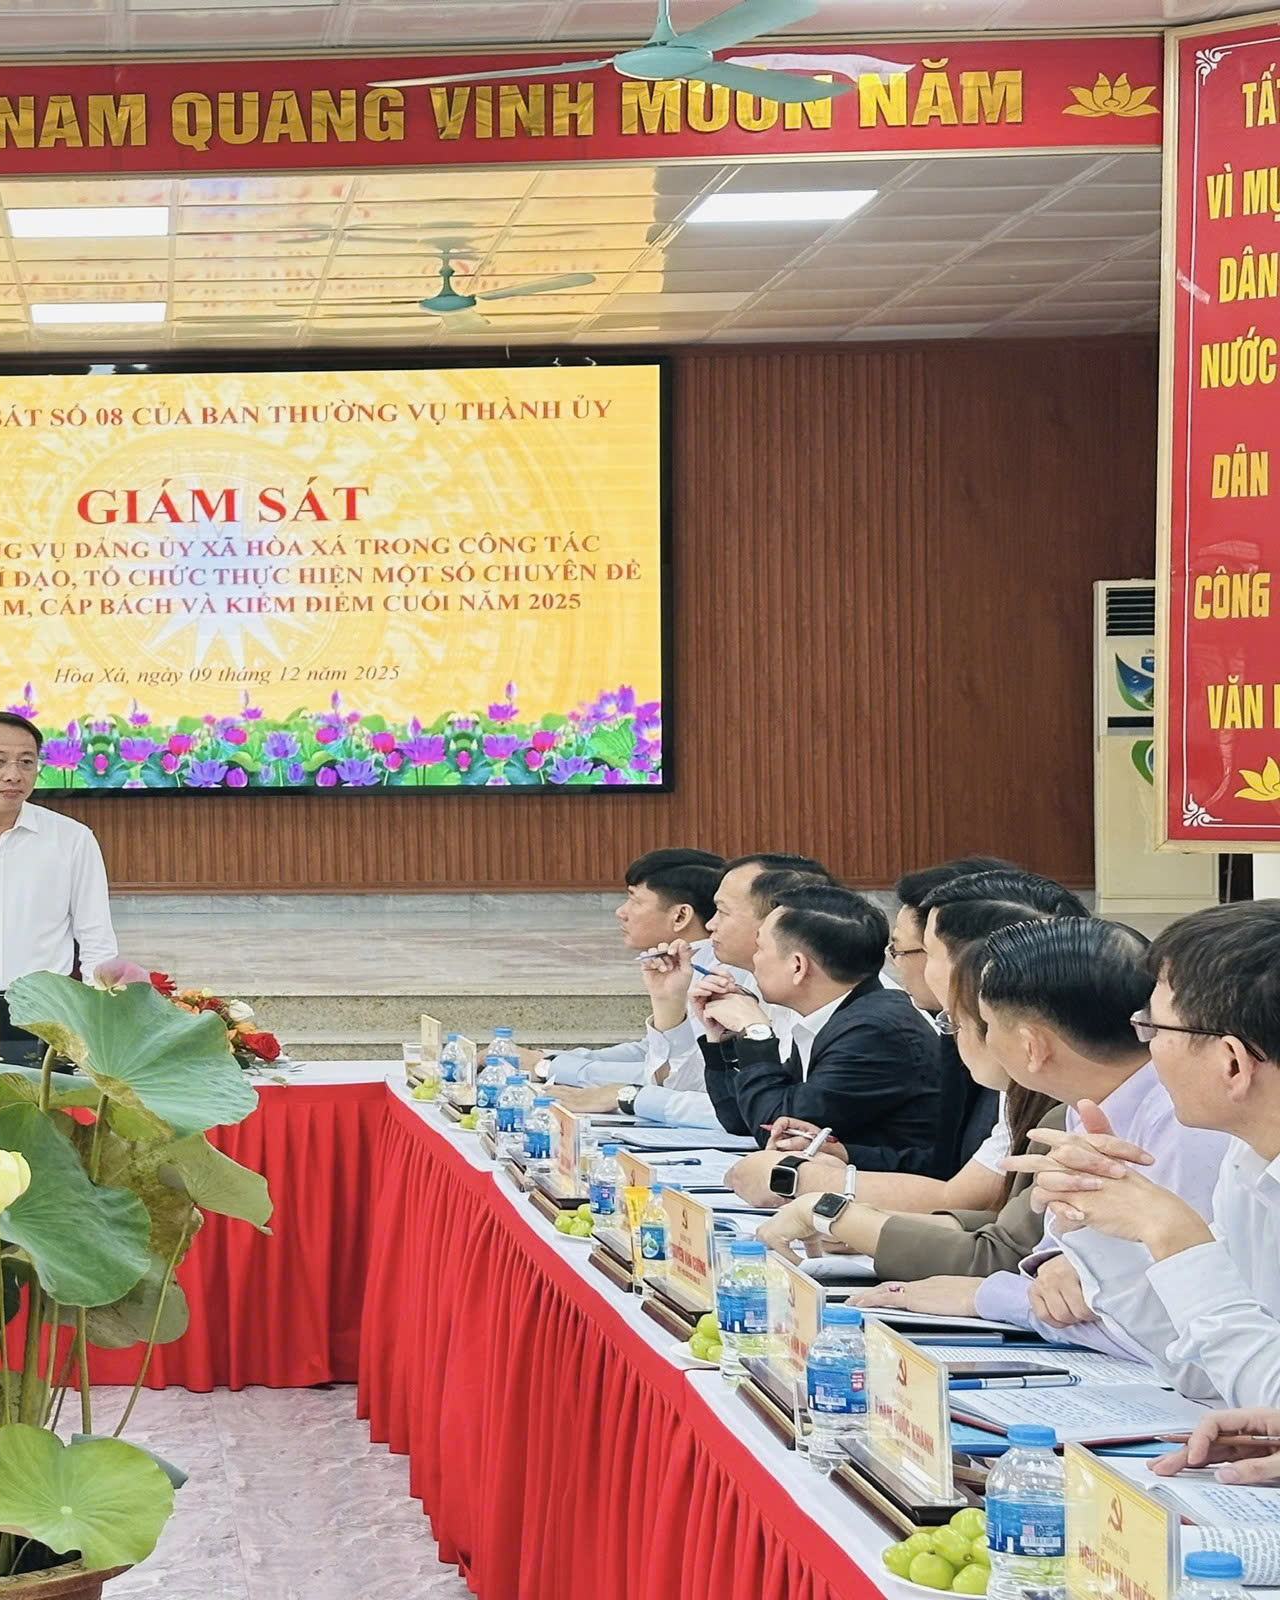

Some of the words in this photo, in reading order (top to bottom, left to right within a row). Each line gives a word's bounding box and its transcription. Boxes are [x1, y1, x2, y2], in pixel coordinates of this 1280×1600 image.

[171, 88, 406, 153] QUANG
[430, 80, 596, 141] VINH
[858, 57, 1024, 129] NĂM
[1206, 163, 1234, 220] VÌ
[1219, 245, 1279, 304] DÂN
[1200, 326, 1278, 389] NƯỚC
[49, 402, 87, 427] SỐ
[96, 406, 123, 426] 08
[131, 400, 193, 426] CỦA
[202, 403, 259, 425] BAN
[268, 399, 398, 424] THƯỜNG
[408, 402, 451, 427] VỤ
[456, 396, 561, 421] THÀNH
[572, 394, 612, 420] ỦY
[1211, 444, 1269, 499] DÂN
[77, 478, 240, 525] GIÁM
[258, 476, 370, 524] SÁT
[14, 570, 78, 592] ĐẠO,
[128, 563, 208, 587] CHỨC
[216, 566, 290, 588] THỰC
[298, 563, 364, 586] HIỆN
[372, 561, 435, 587] MỘT
[441, 559, 475, 583] SỐ
[483, 557, 597, 582] CHUYÊN
[607, 557, 642, 581] ĐỀ
[31, 541, 66, 564] VỤ
[75, 537, 149, 560] ĐẢNG
[160, 535, 194, 558] ỦY
[202, 535, 238, 557] XÃ
[246, 535, 304, 557] HÒA
[311, 532, 347, 556] XÁ
[355, 537, 451, 556] TRONG
[459, 532, 537, 555] CÔNG
[544, 530, 601, 553] TÁC
[40, 593, 93, 617] CẤP
[100, 595, 172, 616] BÁCH
[180, 593, 217, 615] VÀ
[226, 593, 295, 615] KIỂM
[305, 592, 374, 614] ĐIỂM
[383, 590, 449, 612] CUỐI
[459, 589, 520, 611] NĂM
[529, 592, 582, 611] 2025
[1193, 565, 1271, 620] CÔNG
[54, 667, 93, 685] Hòa
[137, 668, 183, 689] ngày
[189, 668, 213, 683] 09
[219, 665, 271, 685] tháng
[280, 666, 301, 683] 12
[306, 666, 347, 682] năm
[354, 665, 400, 681] 2025
[1207, 675, 1263, 730] VĂN
